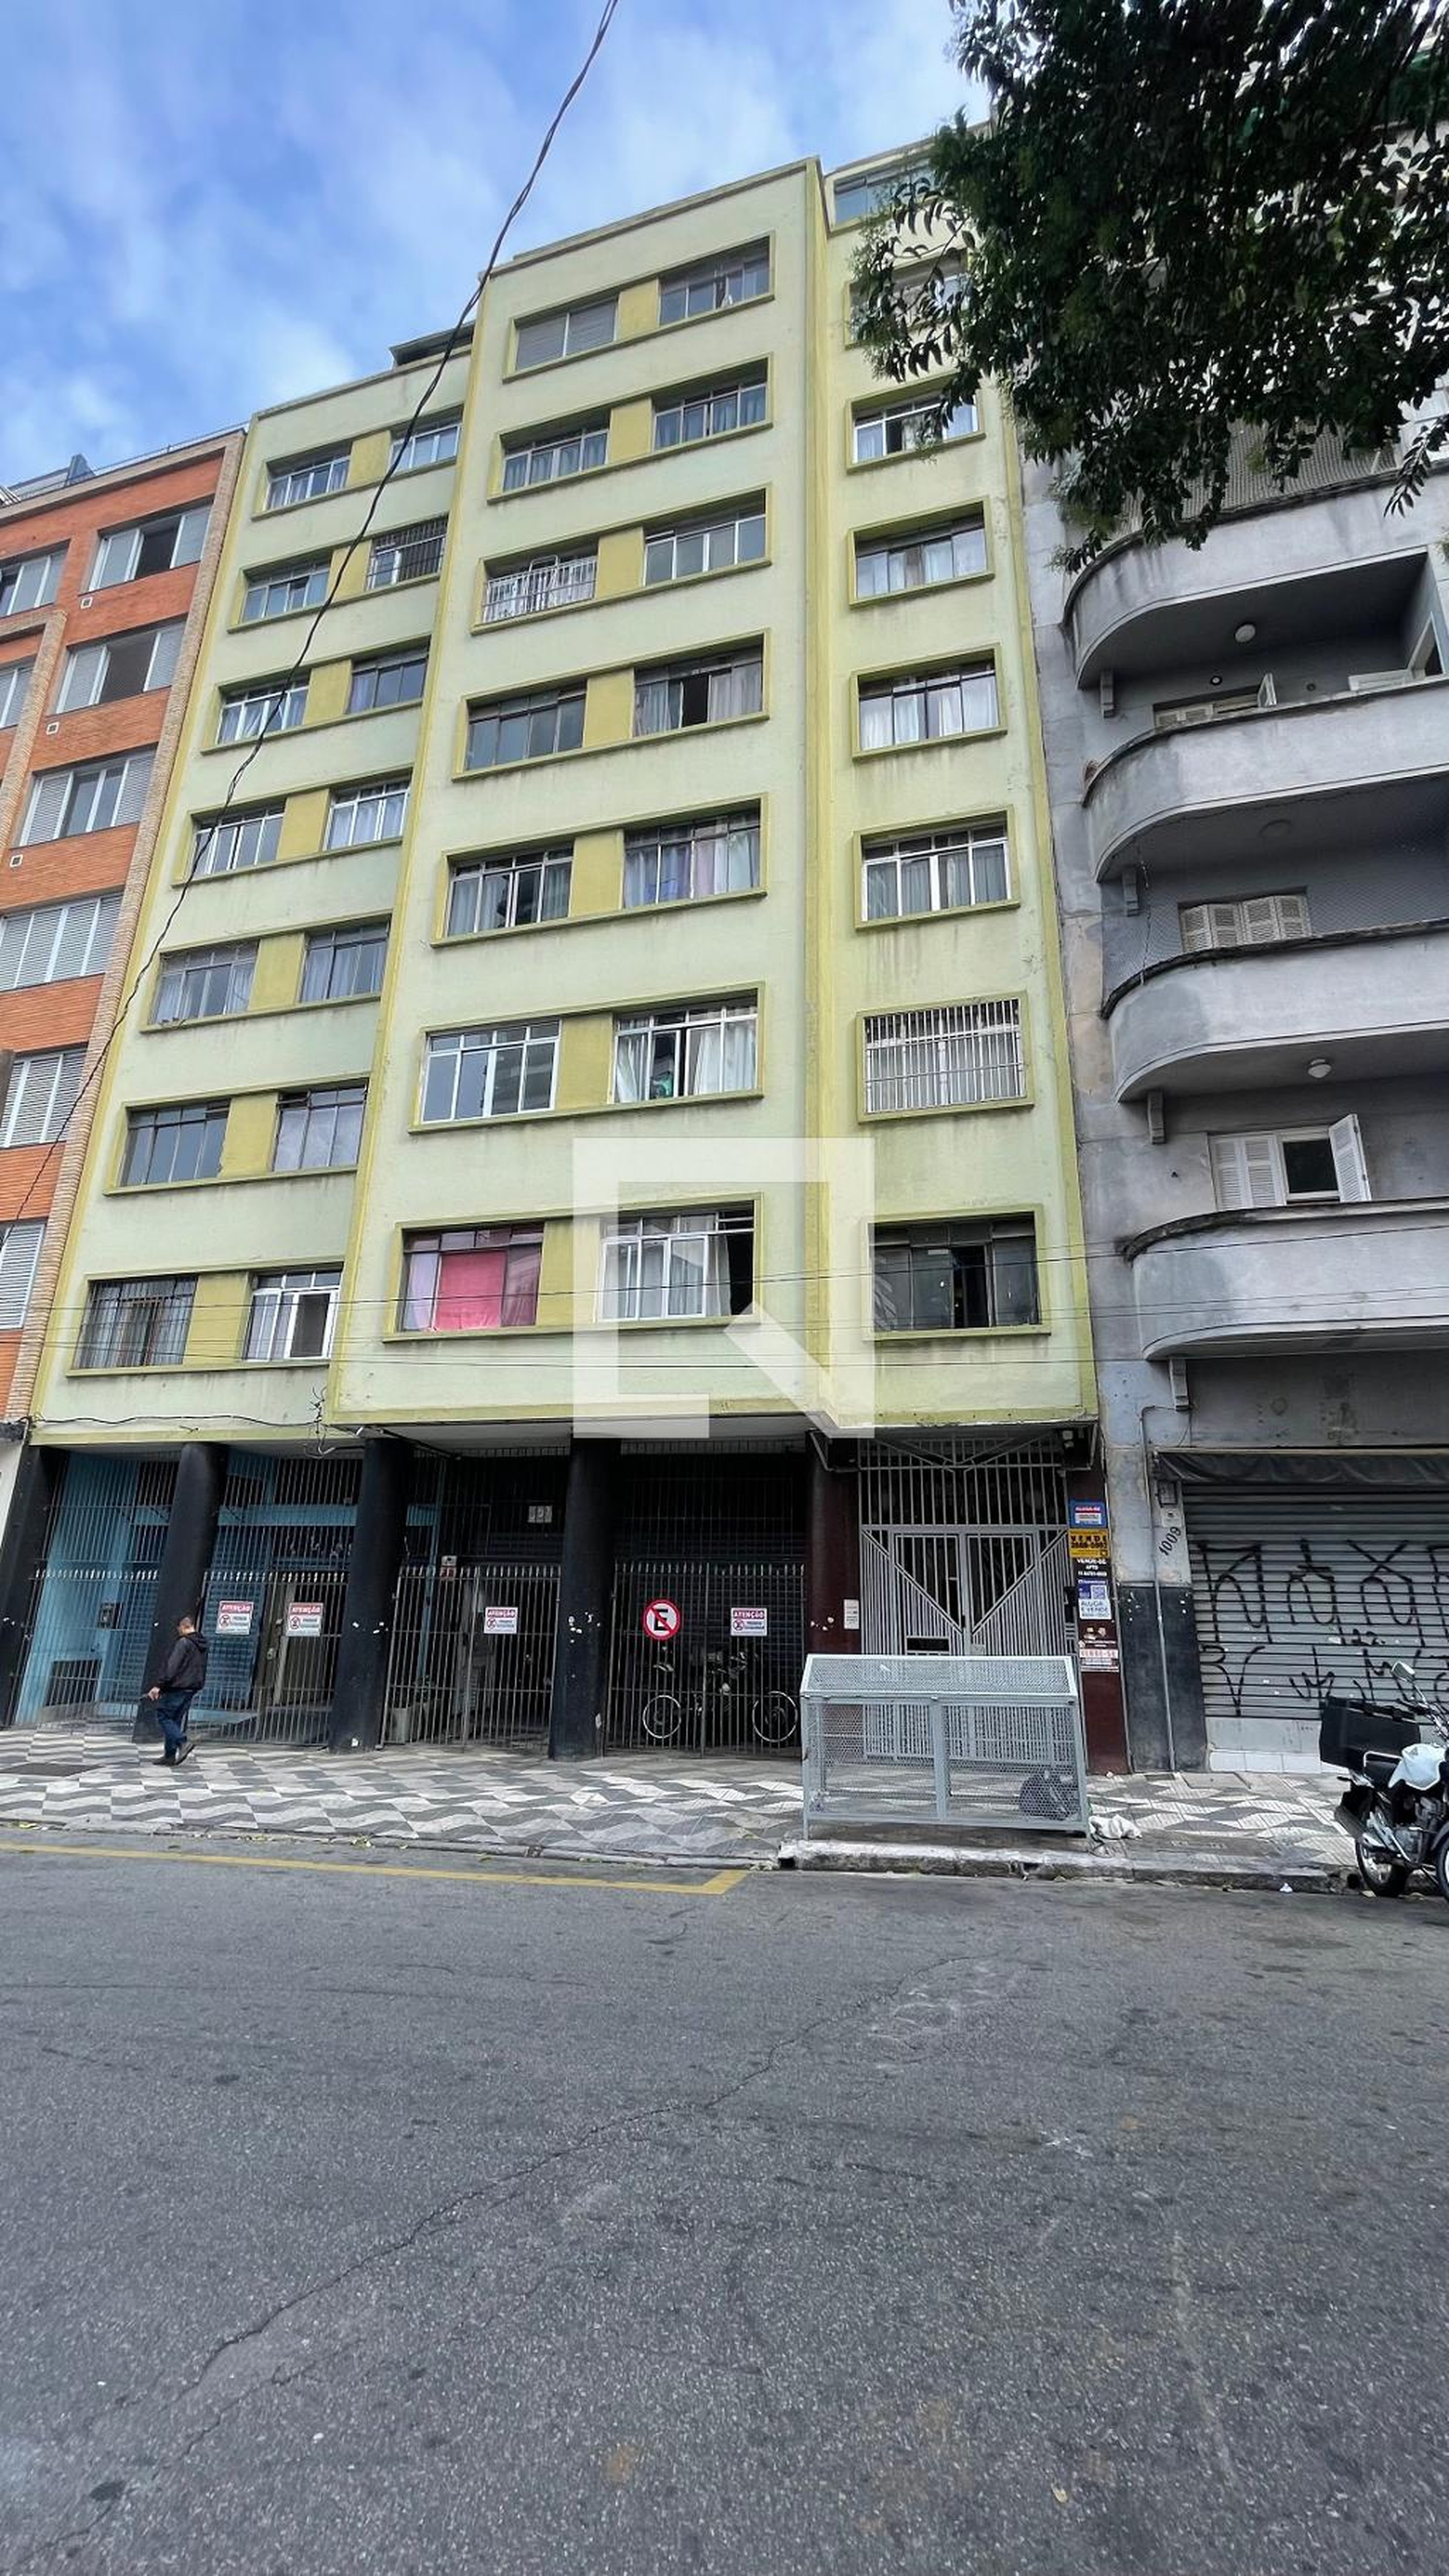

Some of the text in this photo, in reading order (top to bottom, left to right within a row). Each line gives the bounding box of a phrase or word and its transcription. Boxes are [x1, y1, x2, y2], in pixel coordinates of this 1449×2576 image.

[221, 1604, 251, 1612] ATENÇÃO
[292, 1606, 321, 1614] ATENÇÃO
[488, 1609, 515, 1618] ATENÇÃO
[734, 1611, 764, 1619] ATENÇÃO
[654, 1609, 670, 1631] E
